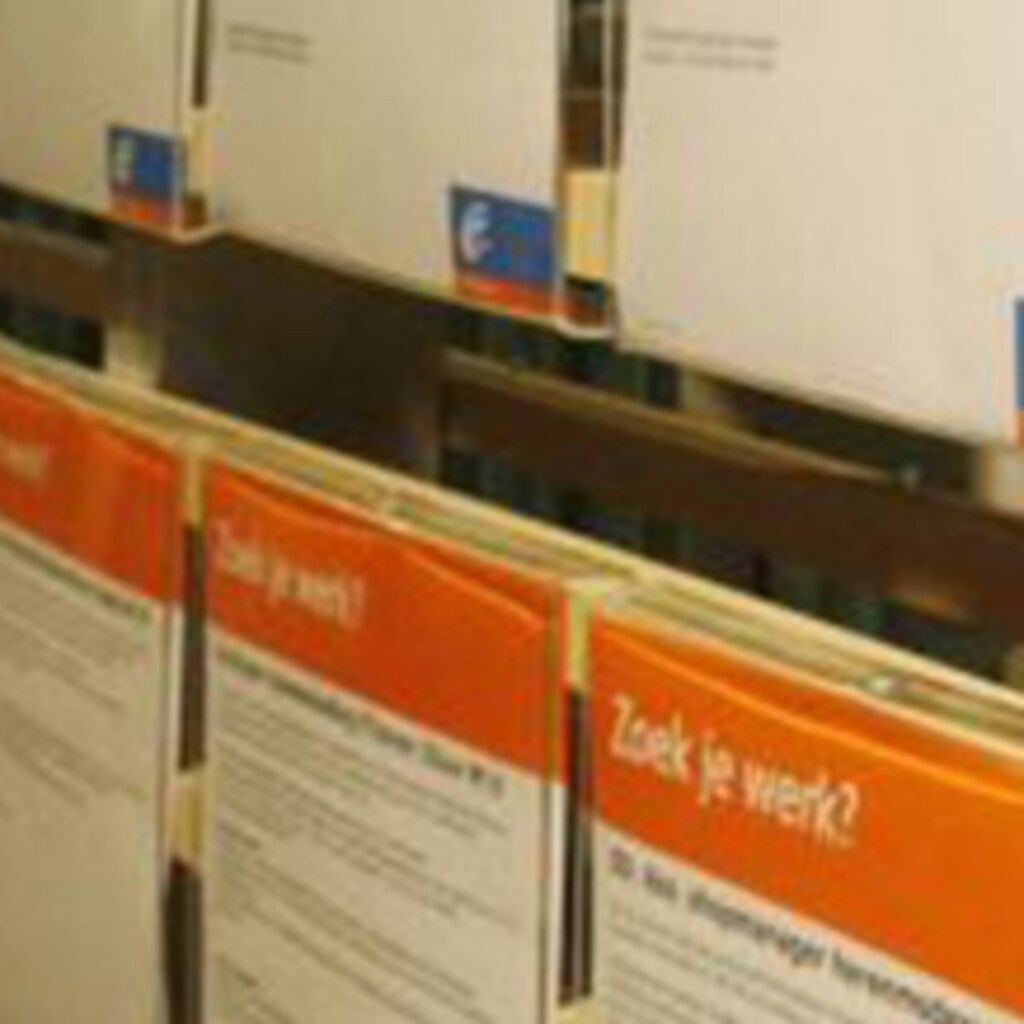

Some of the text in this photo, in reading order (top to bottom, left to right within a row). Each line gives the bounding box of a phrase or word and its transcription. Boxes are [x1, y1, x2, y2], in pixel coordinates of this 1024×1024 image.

[610, 693, 693, 783] Zoek
[697, 728, 735, 808] je
[741, 761, 860, 849] werk?
